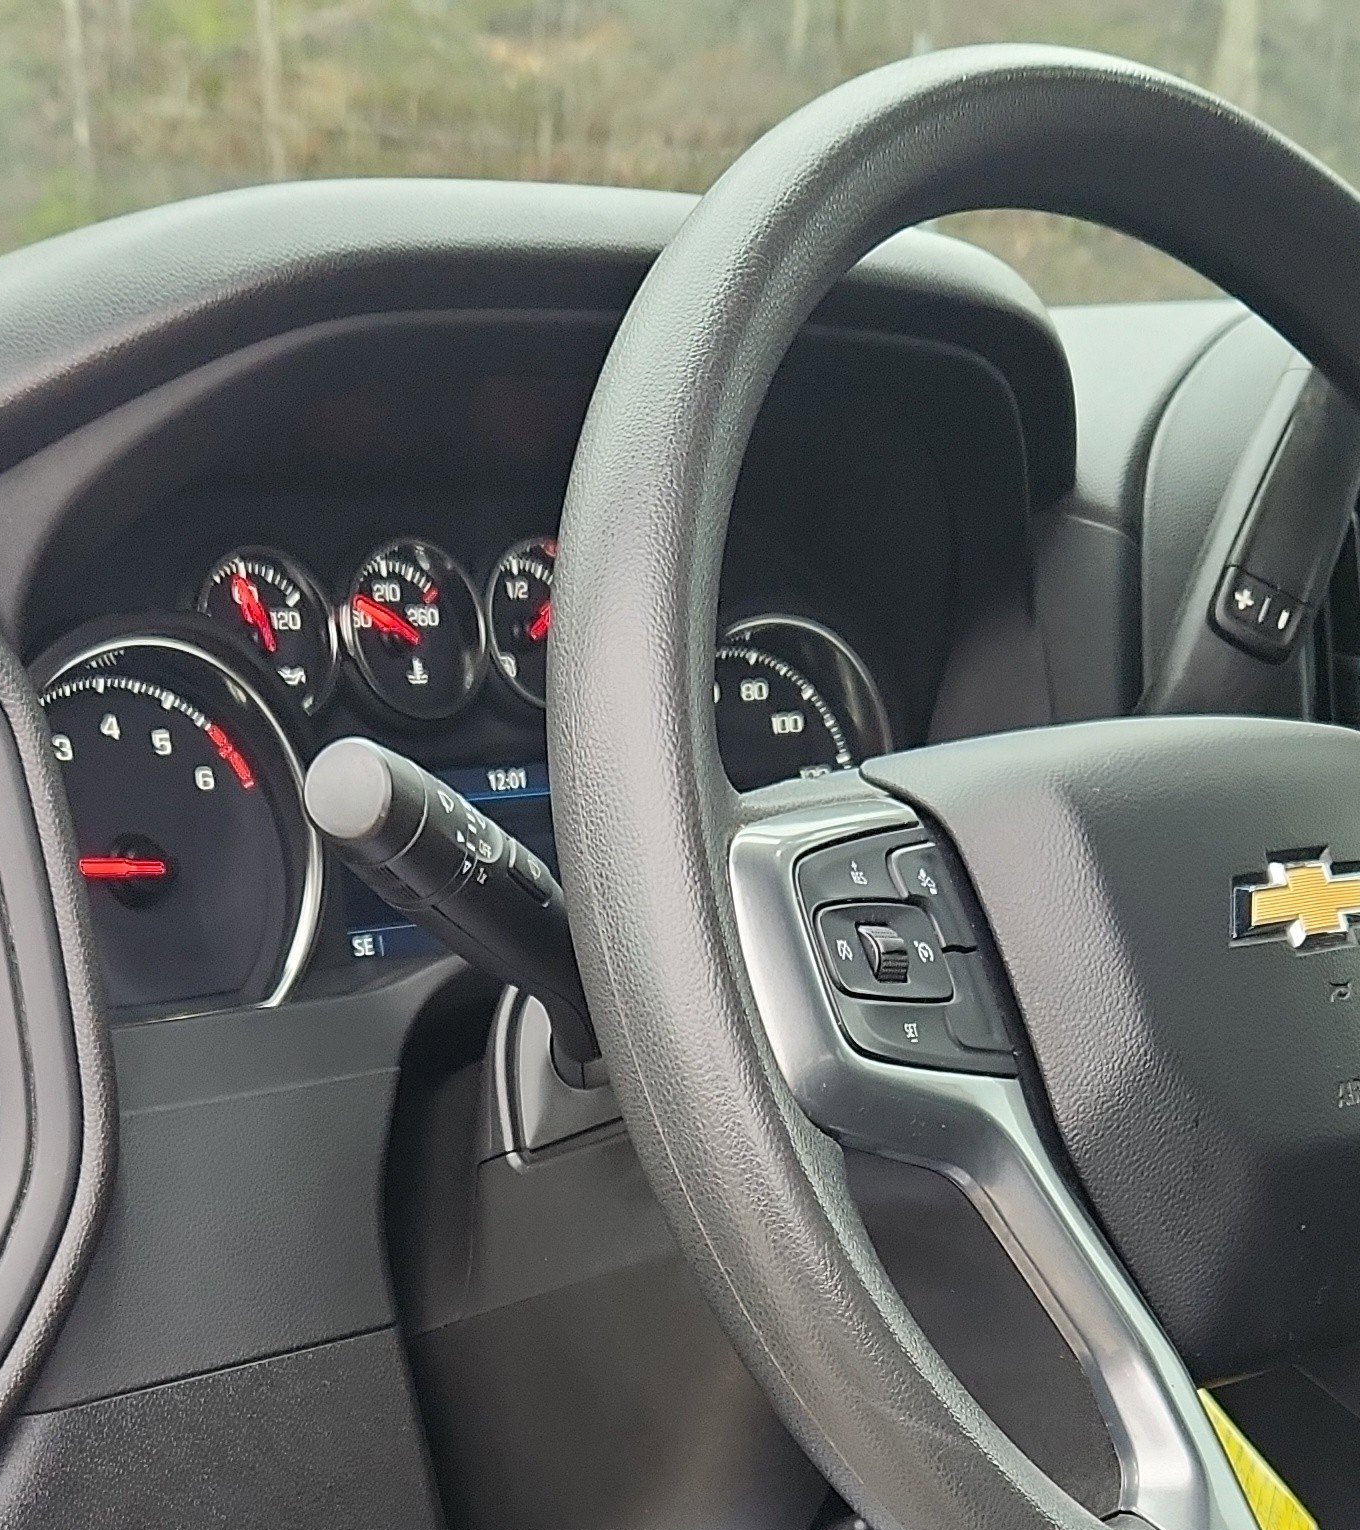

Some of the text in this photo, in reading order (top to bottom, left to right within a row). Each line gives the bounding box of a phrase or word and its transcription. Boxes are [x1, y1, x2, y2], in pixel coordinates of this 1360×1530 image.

[371, 582, 401, 602] 210
[505, 580, 529, 600] 1/2
[270, 610, 302, 630] 120
[405, 606, 440, 627] 260
[740, 680, 769, 701] 80
[100, 713, 121, 740] 4
[771, 712, 804, 735] 100
[51, 734, 73, 761] 3
[151, 728, 172, 756] 5
[194, 765, 215, 791] 6
[487, 769, 528, 792] 12:01
[352, 935, 375, 957] SE
